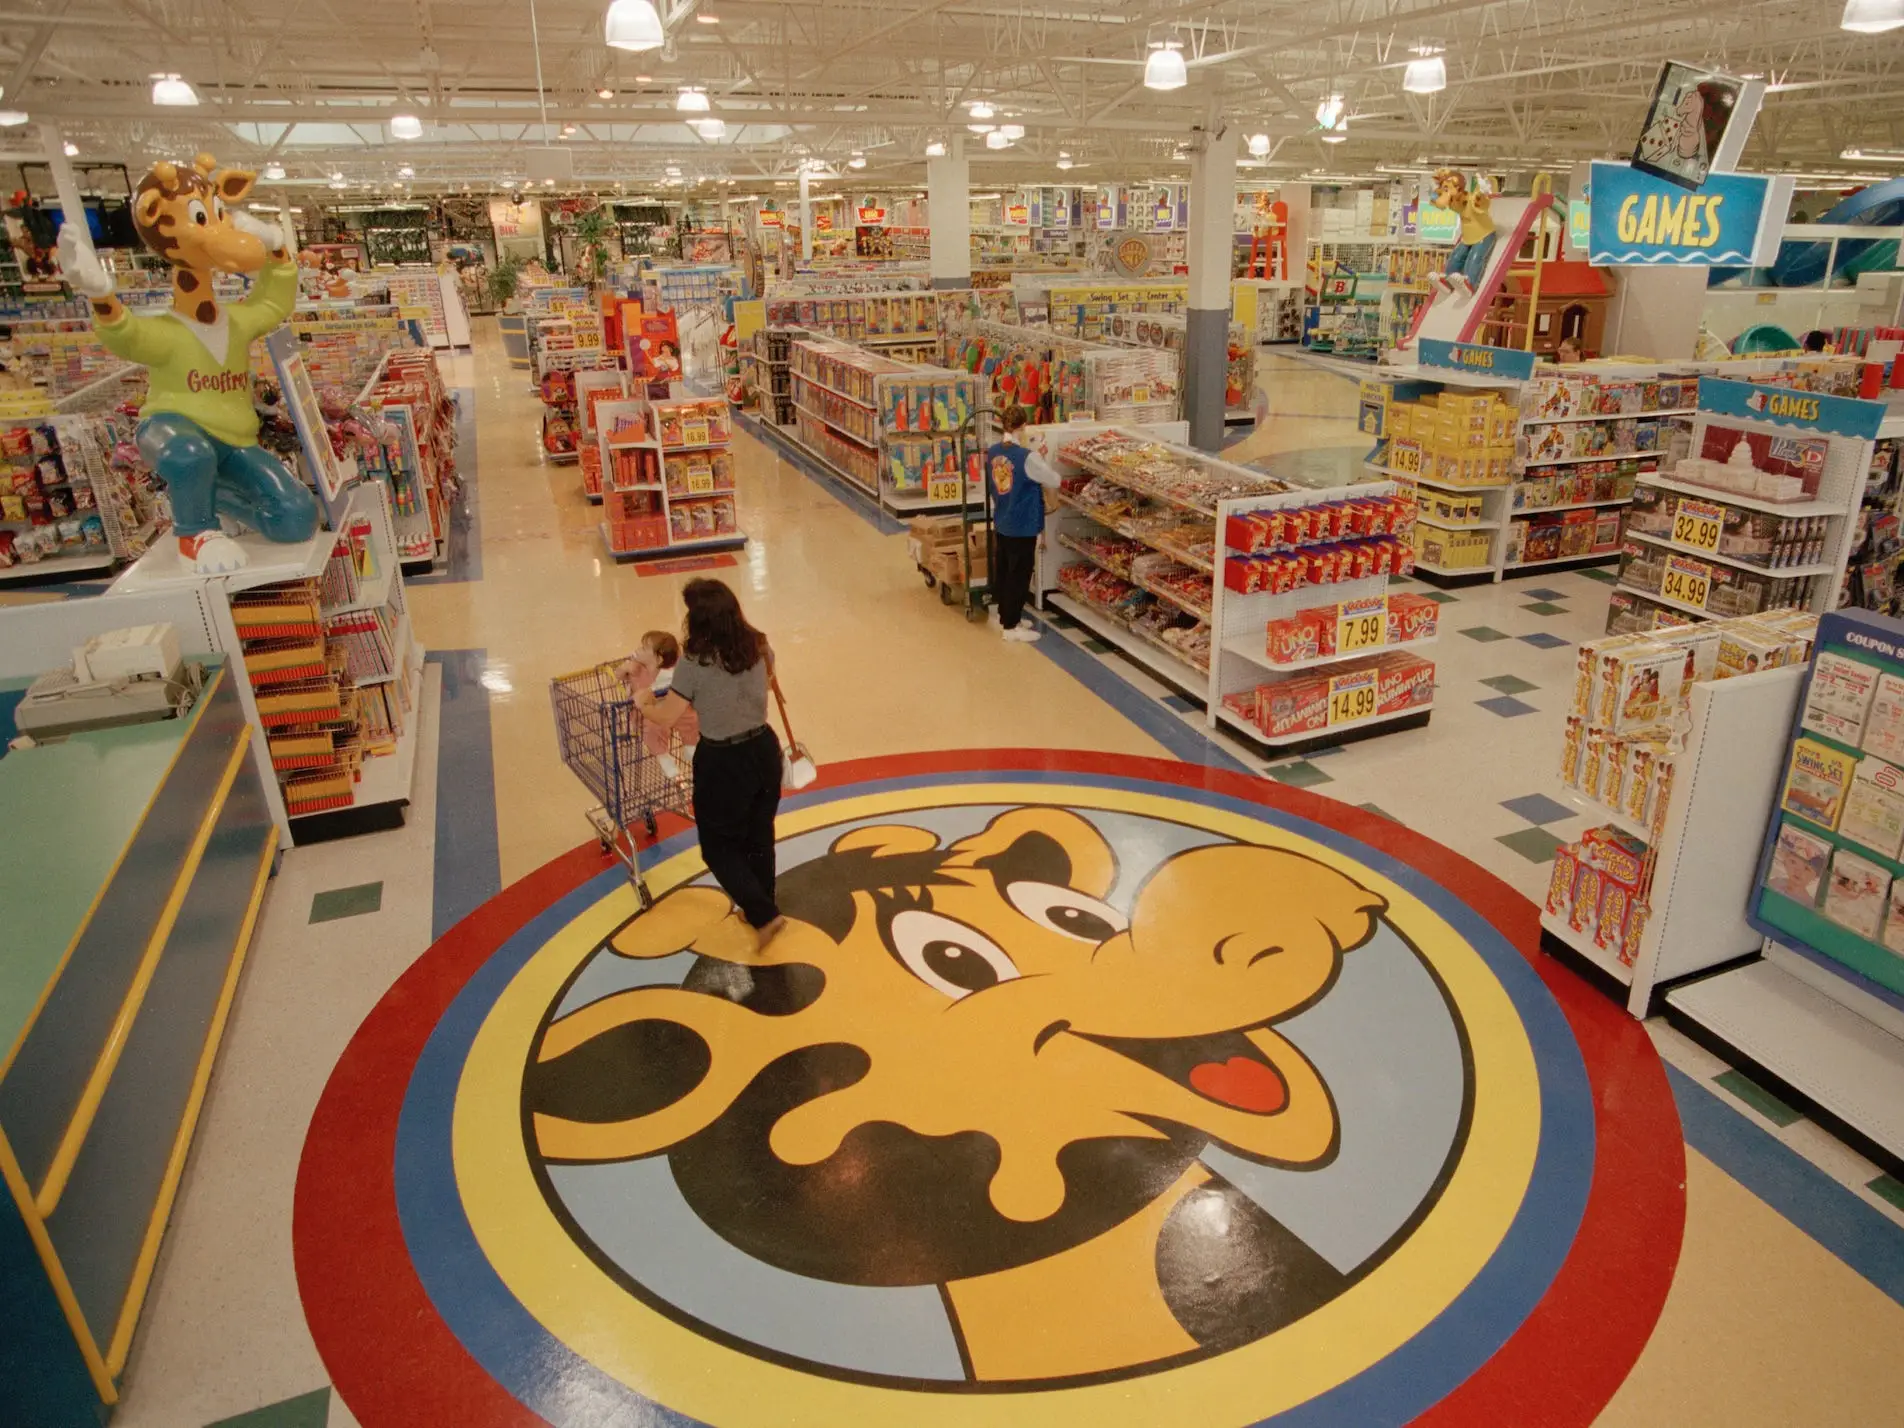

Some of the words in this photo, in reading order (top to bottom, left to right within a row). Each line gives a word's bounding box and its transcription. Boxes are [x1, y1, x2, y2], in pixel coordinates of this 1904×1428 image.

[1617, 193, 1724, 247] GAMES
[1090, 291, 1113, 302] Swing
[577, 333, 599, 347] 9.99
[1462, 349, 1494, 368] GAMES
[1769, 394, 1820, 421] GAMES
[1394, 451, 1419, 472] 14.99
[933, 482, 957, 499] 4.99
[1675, 516, 1718, 548] 32.99
[1665, 571, 1706, 604] 34.99
[1345, 616, 1379, 648] 7.99
[1404, 606, 1434, 633] UNO
[1280, 626, 1315, 654] UNO
[1845, 632, 1895, 655] COUPON
[1379, 672, 1402, 692] UNO
[1332, 688, 1374, 720] 14.99
[1796, 751, 1825, 773] SWING
[1827, 764, 1844, 781] SET
